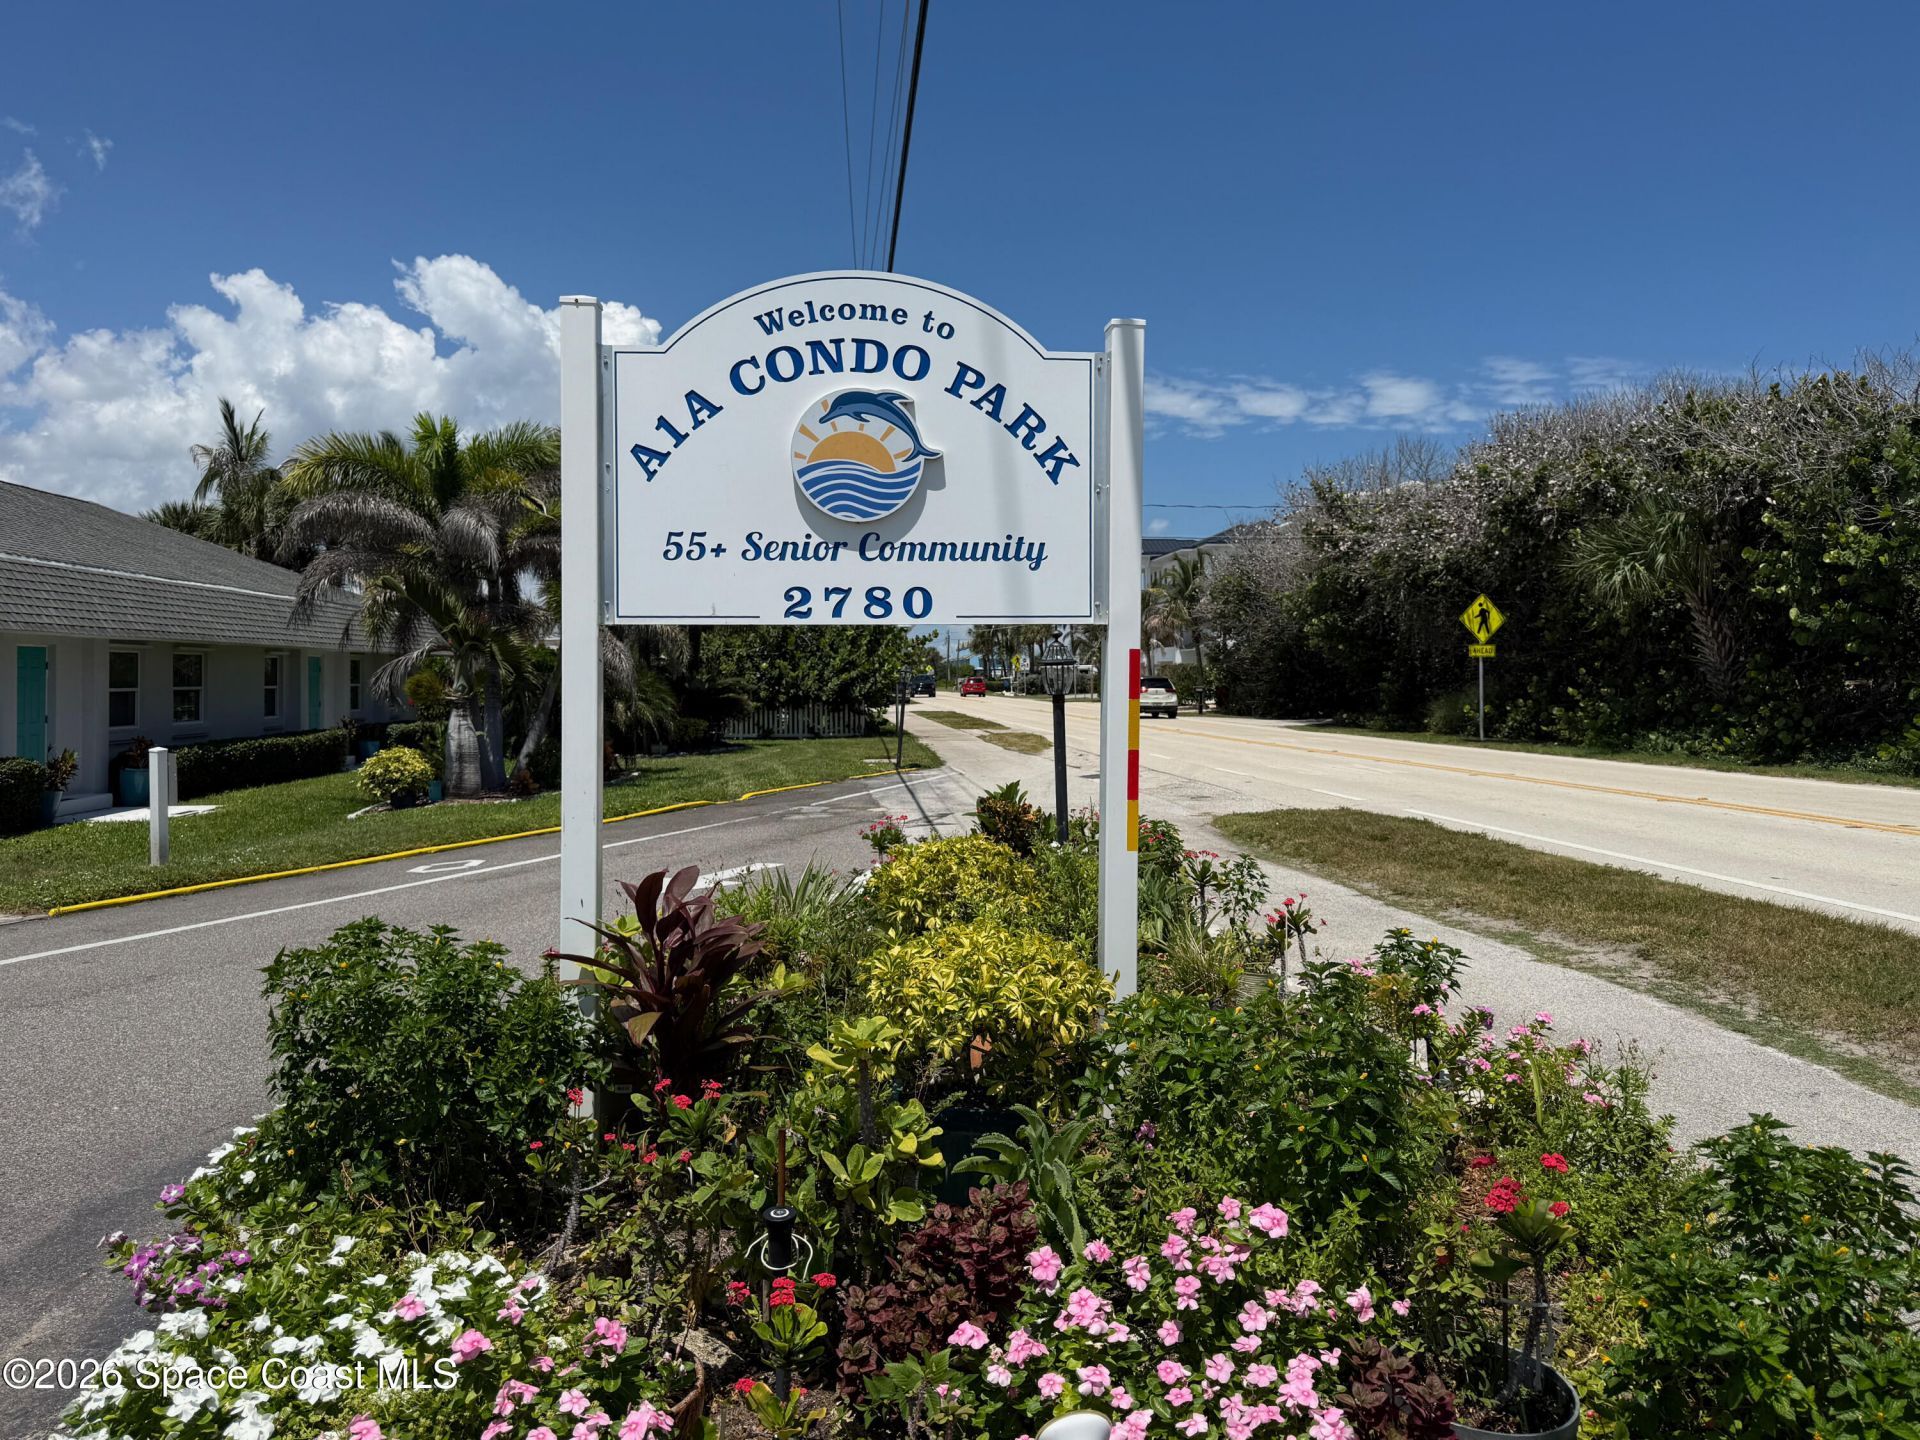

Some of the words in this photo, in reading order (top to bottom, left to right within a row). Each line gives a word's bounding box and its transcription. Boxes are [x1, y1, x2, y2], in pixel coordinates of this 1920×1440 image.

[754, 300, 908, 337] Welcome
[922, 310, 956, 340] to
[629, 388, 724, 483] A1A
[728, 337, 931, 396] CONDO
[944, 360, 1080, 485] PARK
[661, 531, 728, 562] 55+
[741, 531, 848, 562] Senior
[858, 531, 1048, 571] Community
[783, 585, 934, 620] 2780
[1472, 647, 1493, 655] AHEAD
